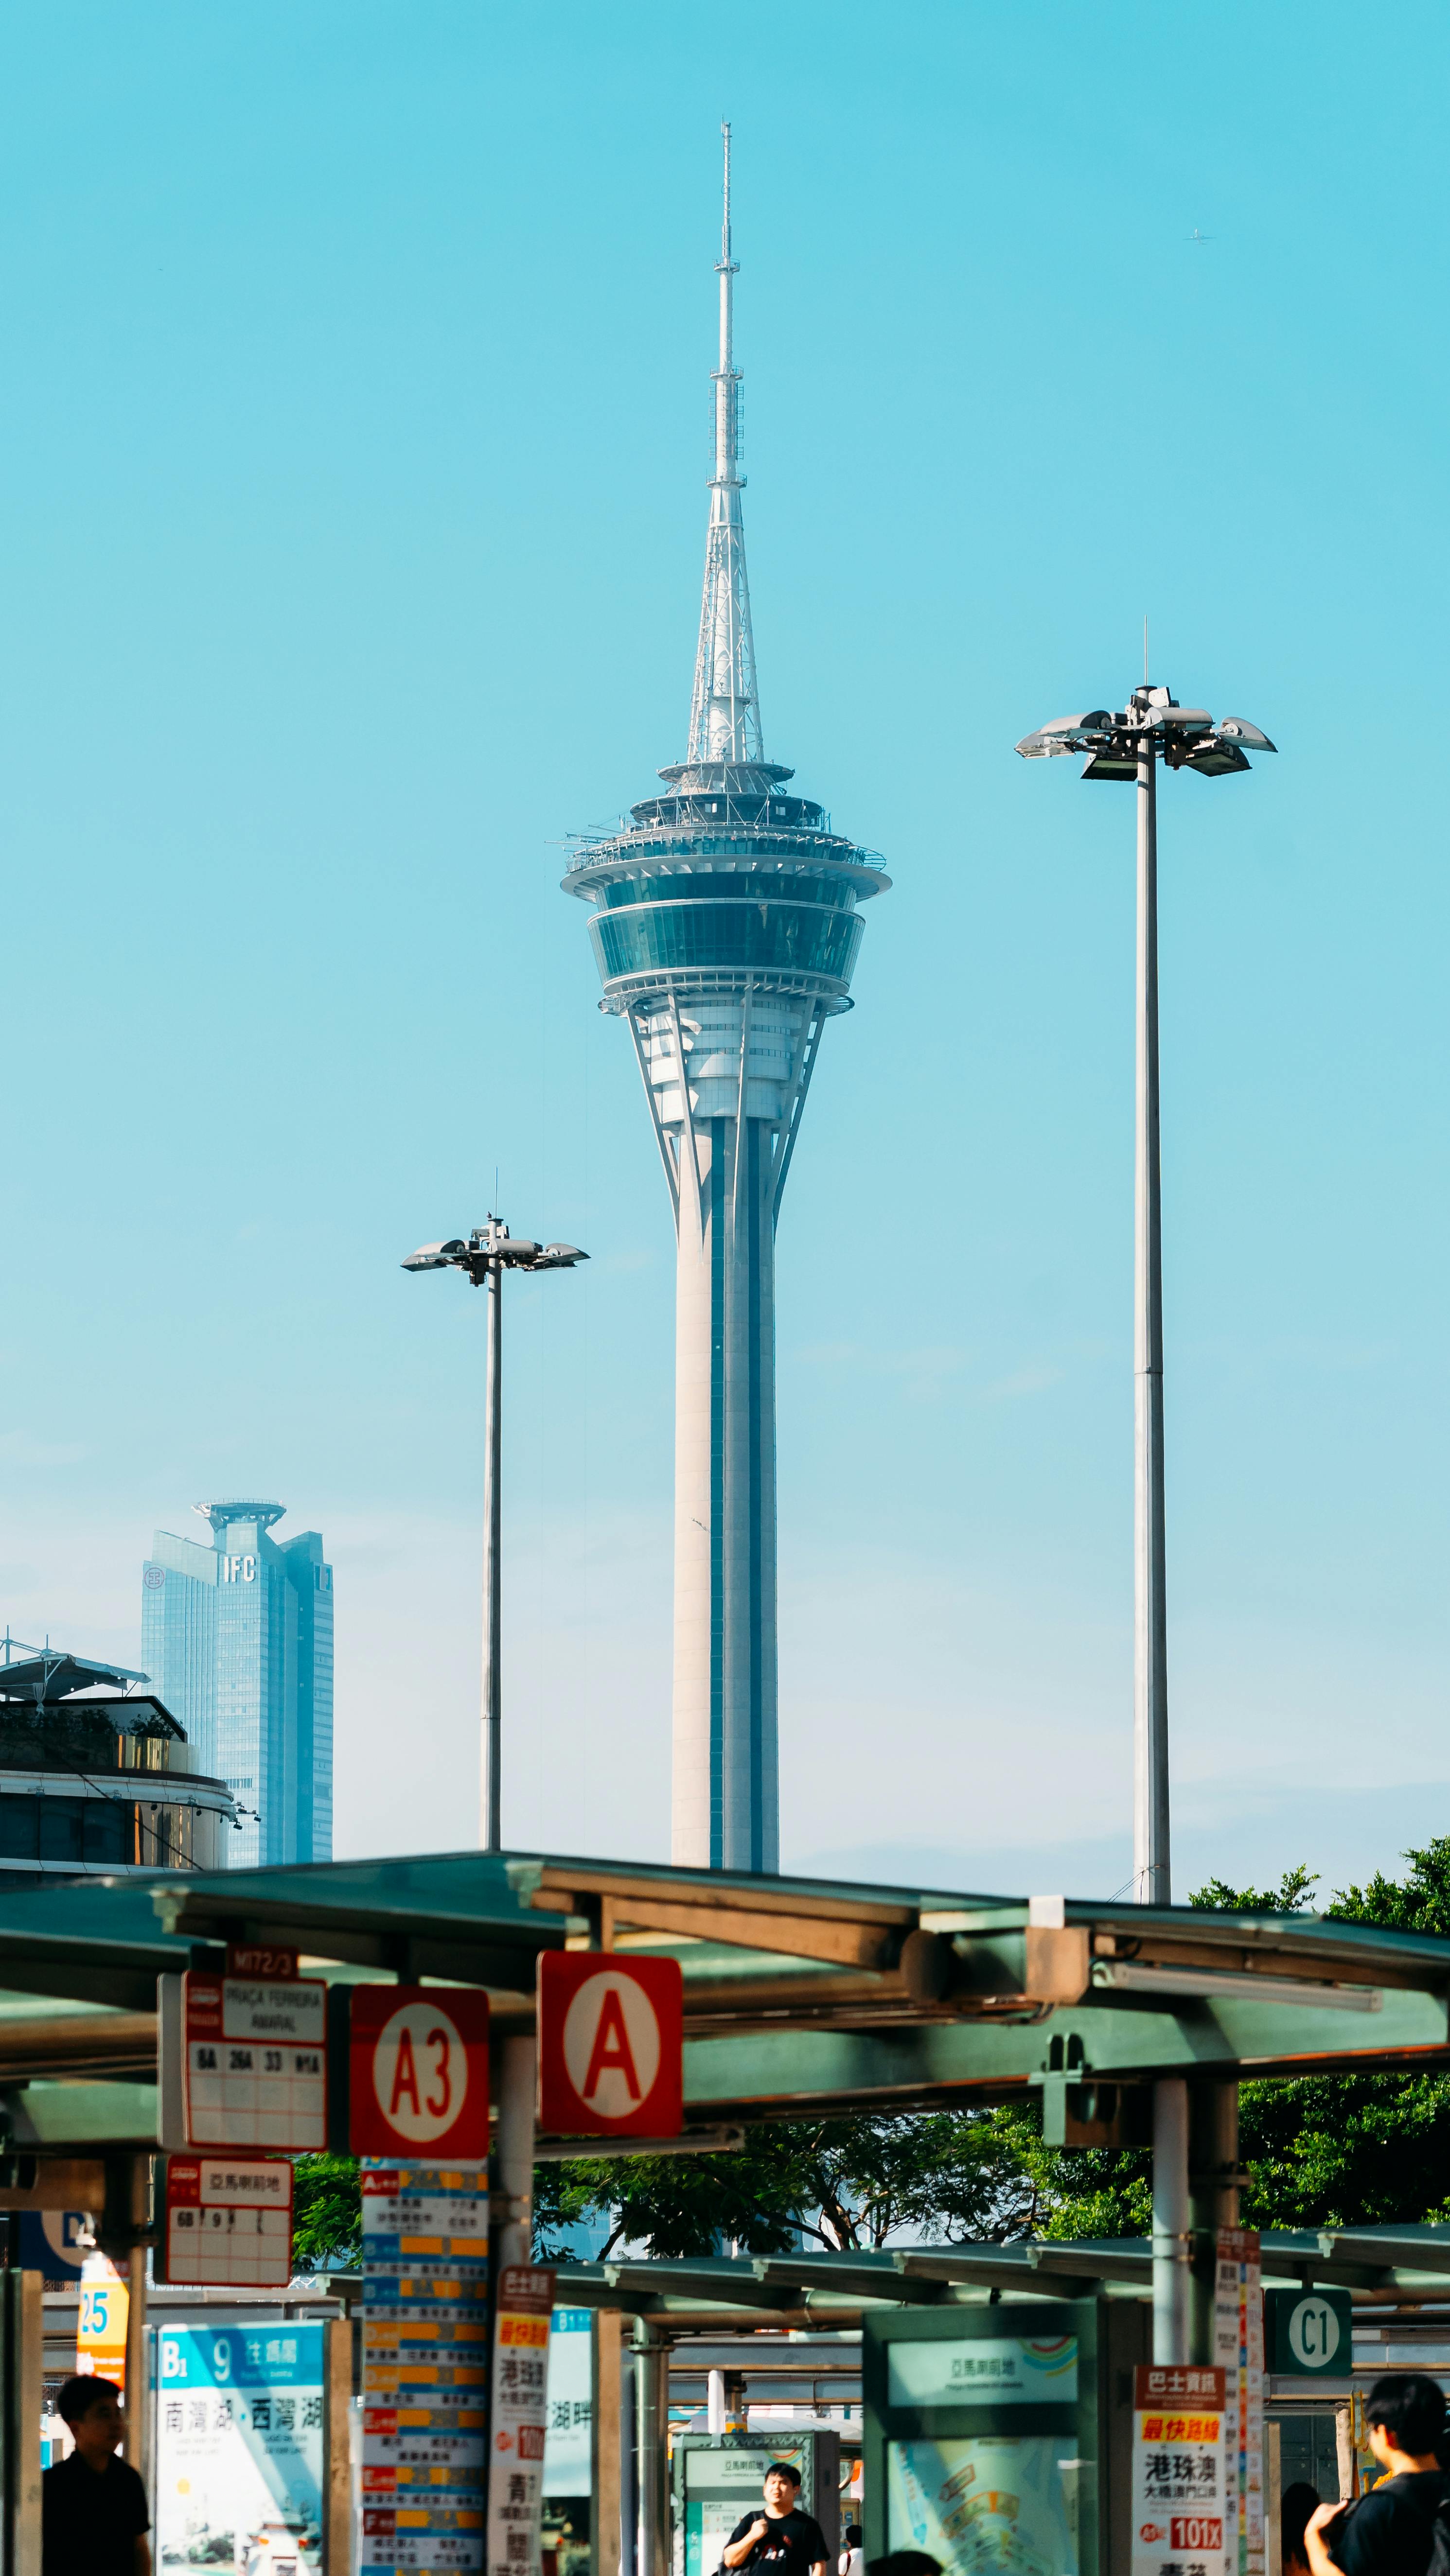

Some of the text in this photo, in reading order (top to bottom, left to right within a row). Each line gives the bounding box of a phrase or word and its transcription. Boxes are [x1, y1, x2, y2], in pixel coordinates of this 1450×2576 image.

[224, 1556, 255, 1582] IFC
[584, 1990, 641, 2100] A
[265, 2051, 282, 2072] 33
[390, 2027, 451, 2118] A3
[210, 2173, 281, 2192] 亞馬喇前地
[212, 2213, 221, 2228] 9
[1302, 2309, 1327, 2355] C1
[163, 2341, 188, 2378] B1
[213, 2339, 232, 2381] 9
[951, 2358, 1015, 2379] 亞馬喇前地
[1149, 2371, 1216, 2393] 巴士資訊
[1144, 2419, 1220, 2441] 最快路線
[725, 2460, 764, 2471] 亞馬喇前地
[1145, 2453, 1216, 2482] 港珠澳
[1175, 2520, 1221, 2548] 101X
